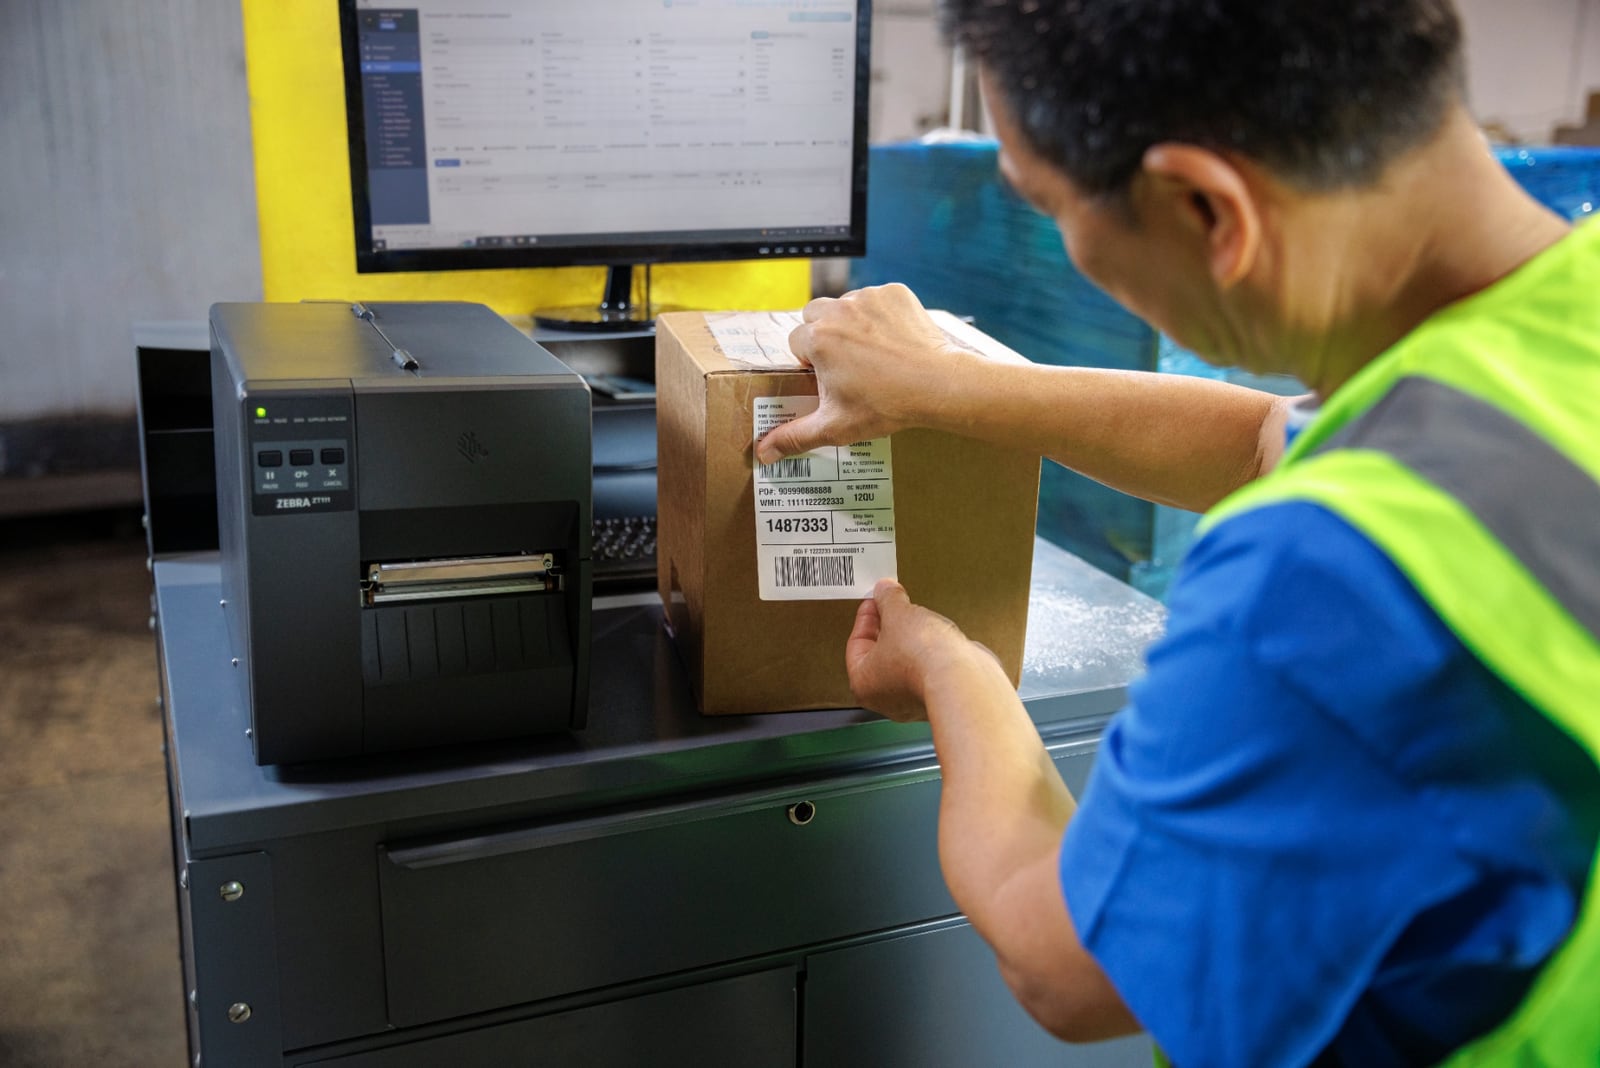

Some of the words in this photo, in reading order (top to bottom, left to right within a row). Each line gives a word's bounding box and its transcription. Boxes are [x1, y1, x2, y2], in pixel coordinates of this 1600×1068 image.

[758, 487, 776, 496] PO#:
[276, 498, 311, 509] ZEBRA
[766, 518, 828, 533] 1487333
